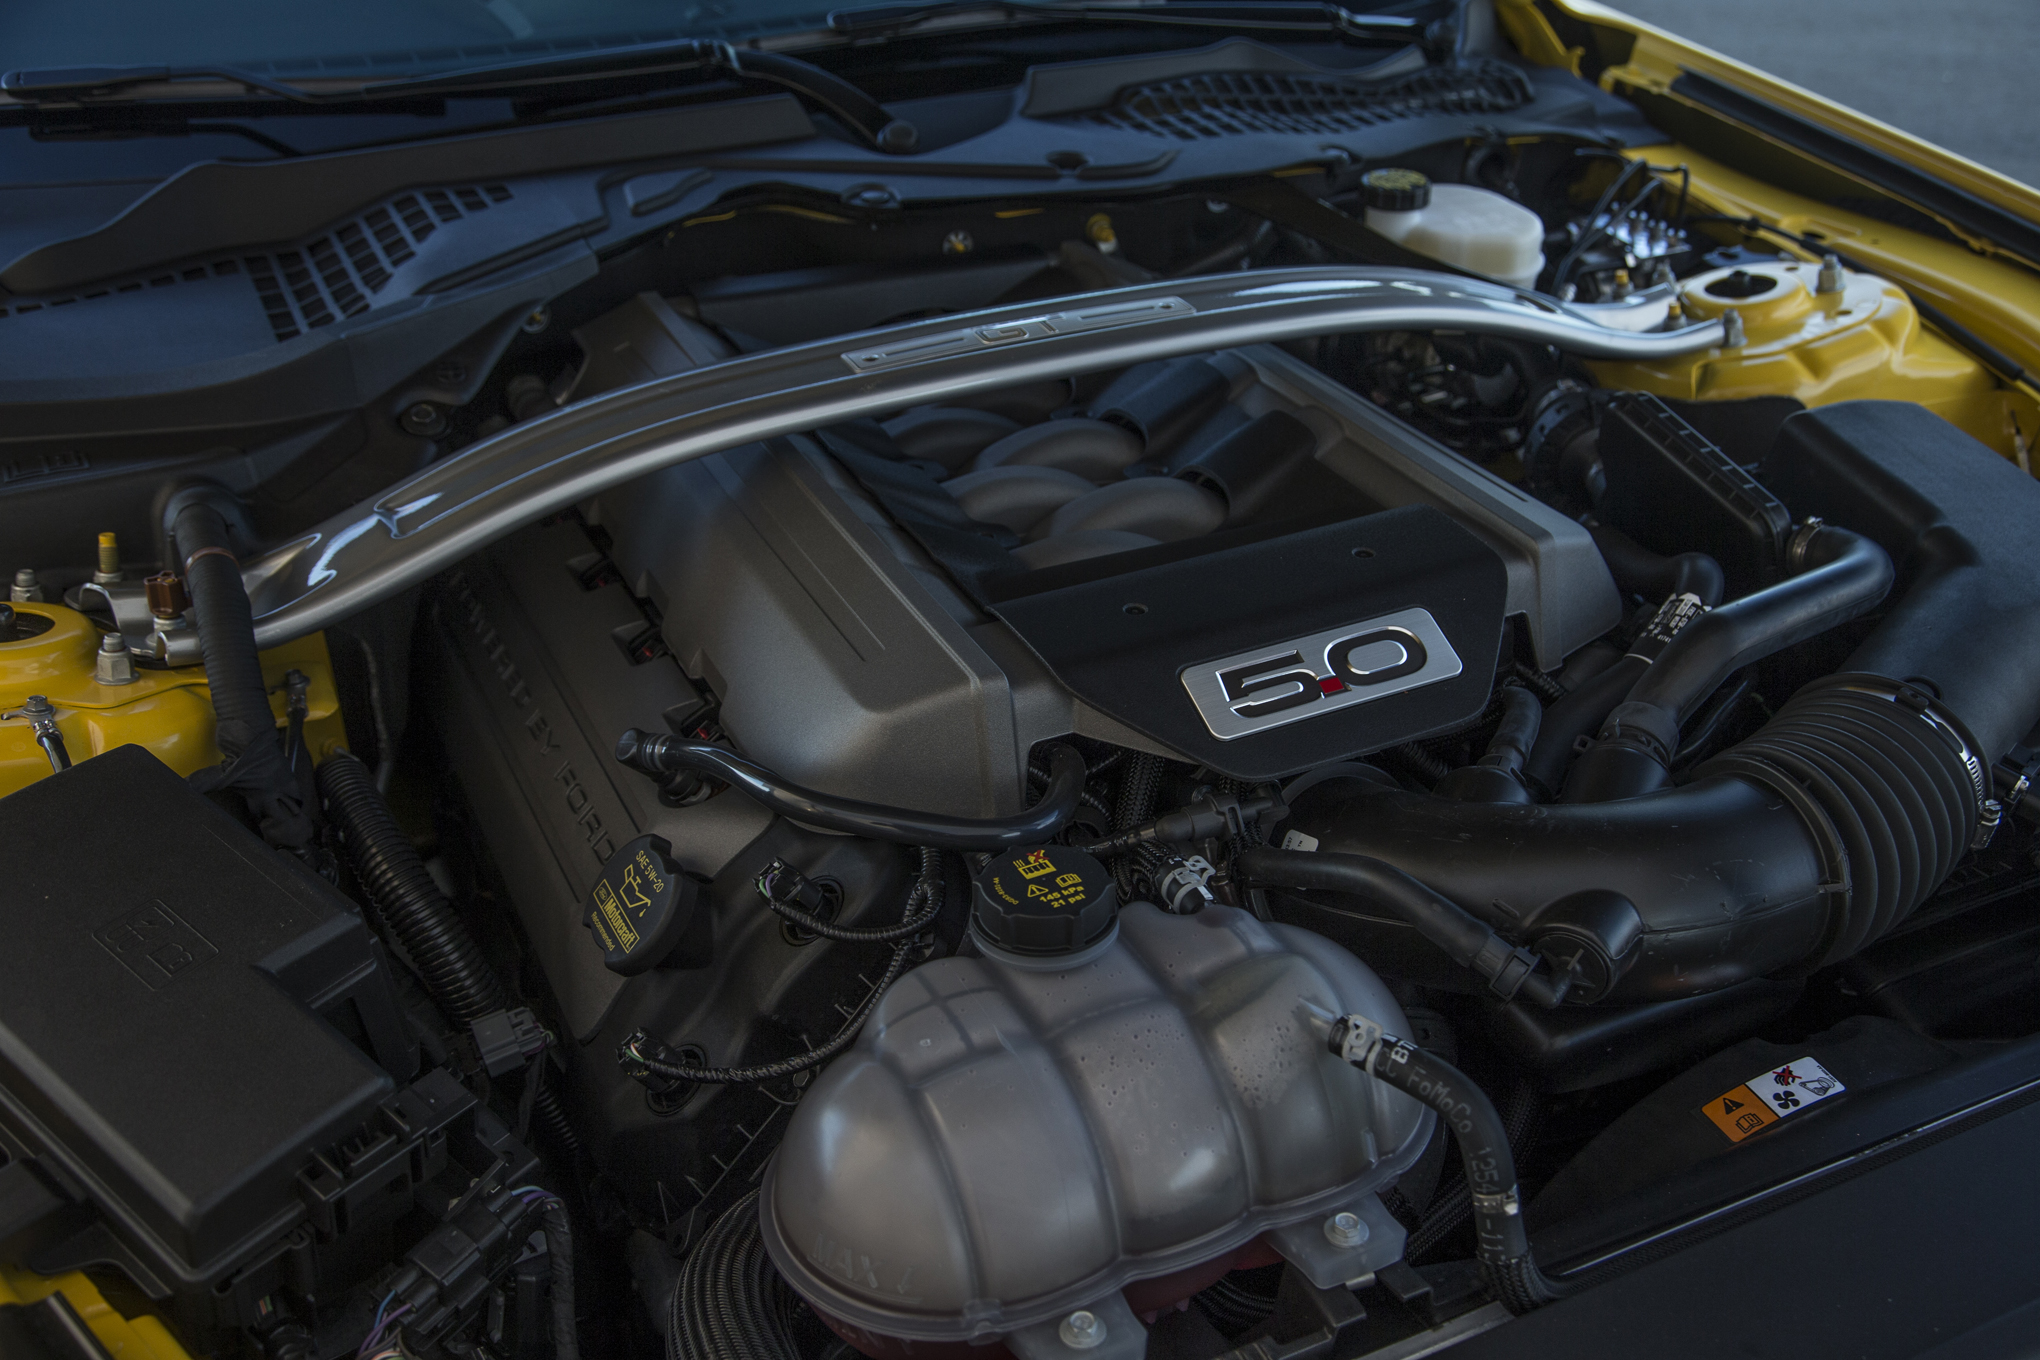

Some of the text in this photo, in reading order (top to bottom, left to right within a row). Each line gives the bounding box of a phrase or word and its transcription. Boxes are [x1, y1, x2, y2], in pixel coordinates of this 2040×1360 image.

[975, 313, 1065, 344] GT
[1215, 625, 1428, 719] 5.0
[524, 708, 561, 757] BY
[554, 759, 617, 867] FORD
[635, 849, 665, 893] SAE 5W-20
[1039, 885, 1085, 902] 145 kPa
[603, 897, 636, 949] Motorcraft
[1050, 892, 1086, 908] 21 psi
[590, 911, 616, 952] Recommended
[1407, 1065, 1473, 1134] FoMoCo
[812, 1232, 882, 1289] MAX
